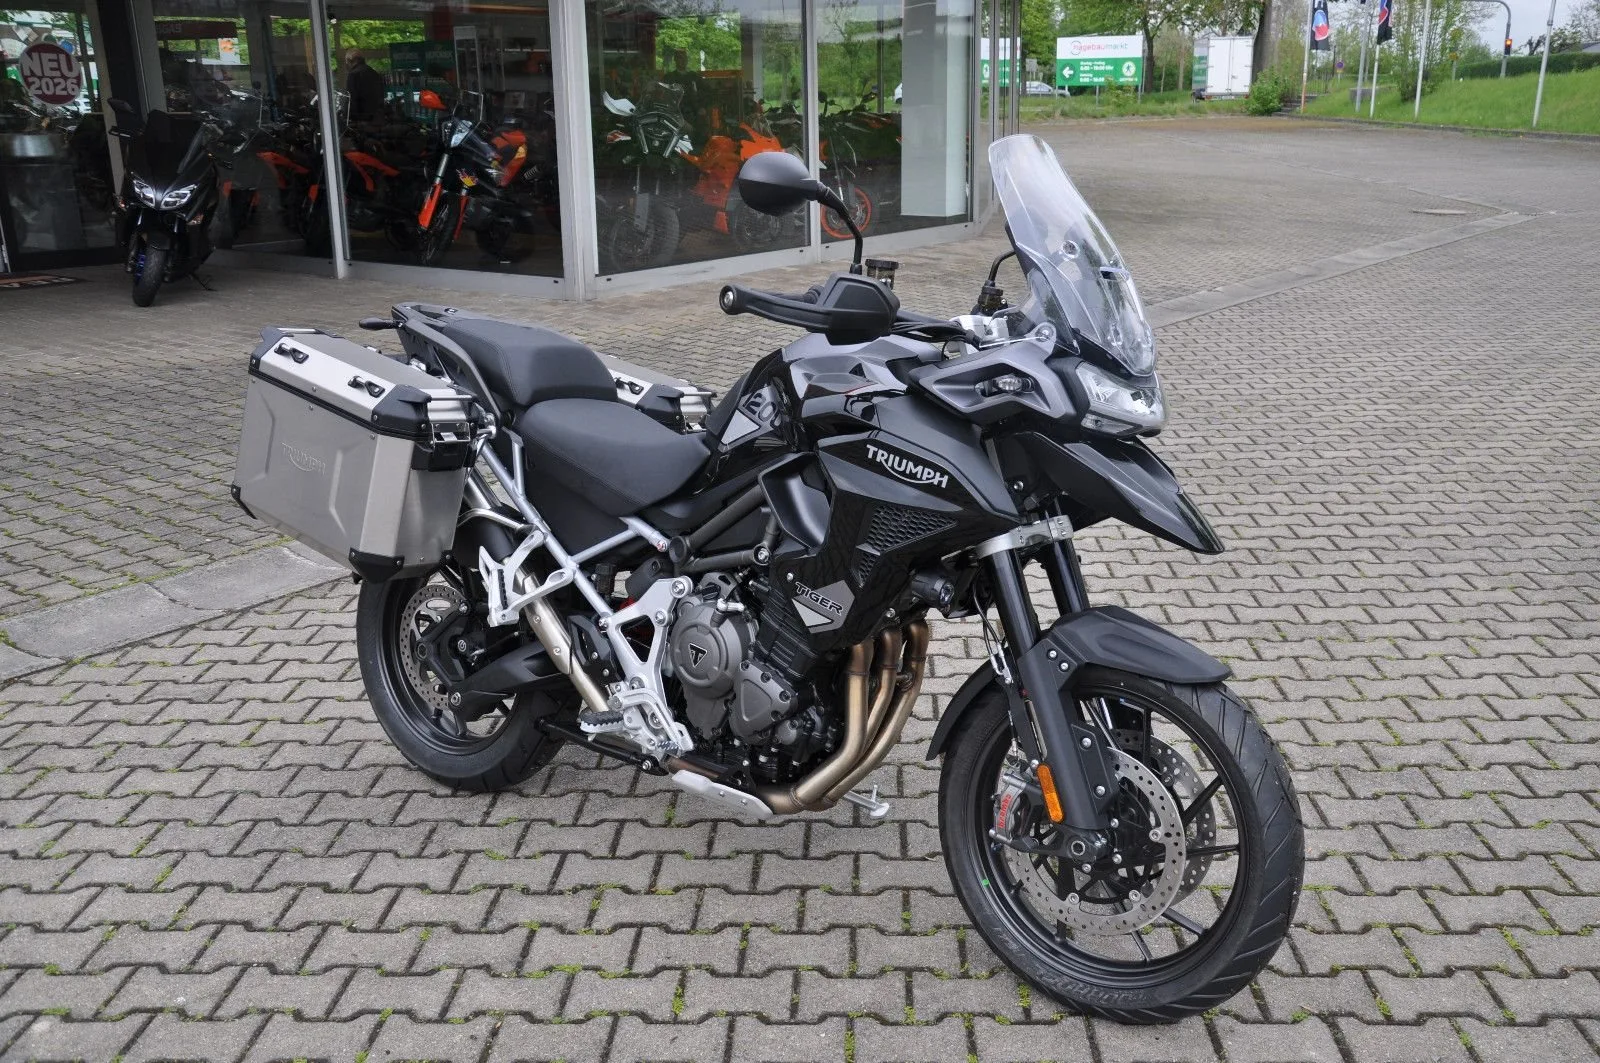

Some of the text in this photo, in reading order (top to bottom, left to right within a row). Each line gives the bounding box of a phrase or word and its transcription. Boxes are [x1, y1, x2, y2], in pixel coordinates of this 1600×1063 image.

[22, 51, 80, 78] NEU
[28, 77, 79, 96] 2026
[281, 441, 326, 476] TRIUMPH
[866, 444, 949, 489] TRIUMPH
[795, 581, 843, 616] TIGER
